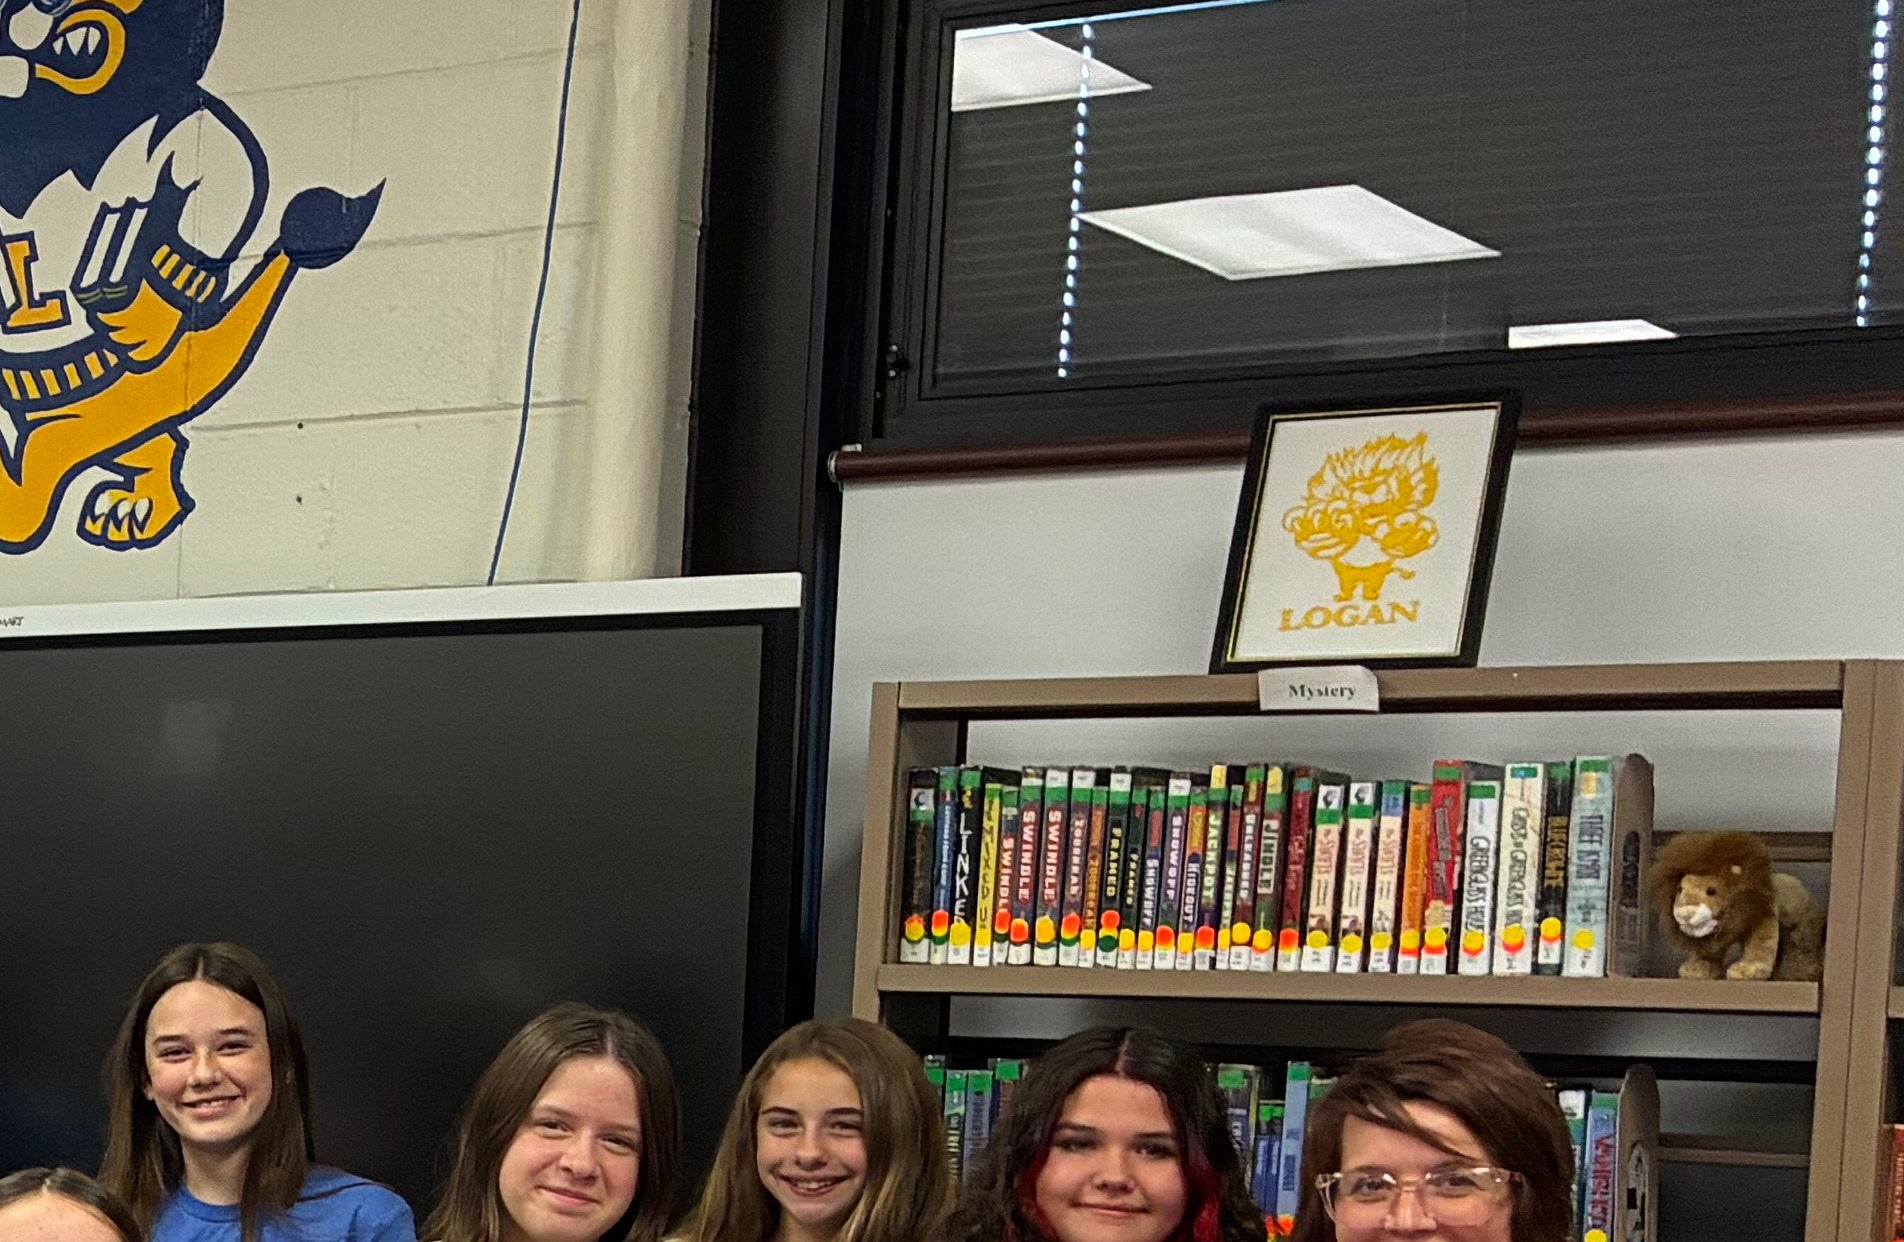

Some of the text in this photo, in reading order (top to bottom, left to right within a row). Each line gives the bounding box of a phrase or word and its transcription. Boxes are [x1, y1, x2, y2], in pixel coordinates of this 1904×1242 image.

[1278, 601, 1420, 632] LOGAN
[1288, 683, 1357, 701] Mystery
[998, 836, 1015, 912] SWINDL
[1017, 809, 1037, 902] SWINDLE
[1043, 809, 1064, 902] SWINDLE
[1105, 827, 1124, 898] FRAMED
[1165, 815, 1183, 900] SHOWOFF
[1201, 815, 1221, 903] JACKPOT
[1238, 813, 1257, 899] UNLEASHED
[1257, 820, 1280, 893] JINGLE
[1181, 862, 1201, 931] HIDEOUT
